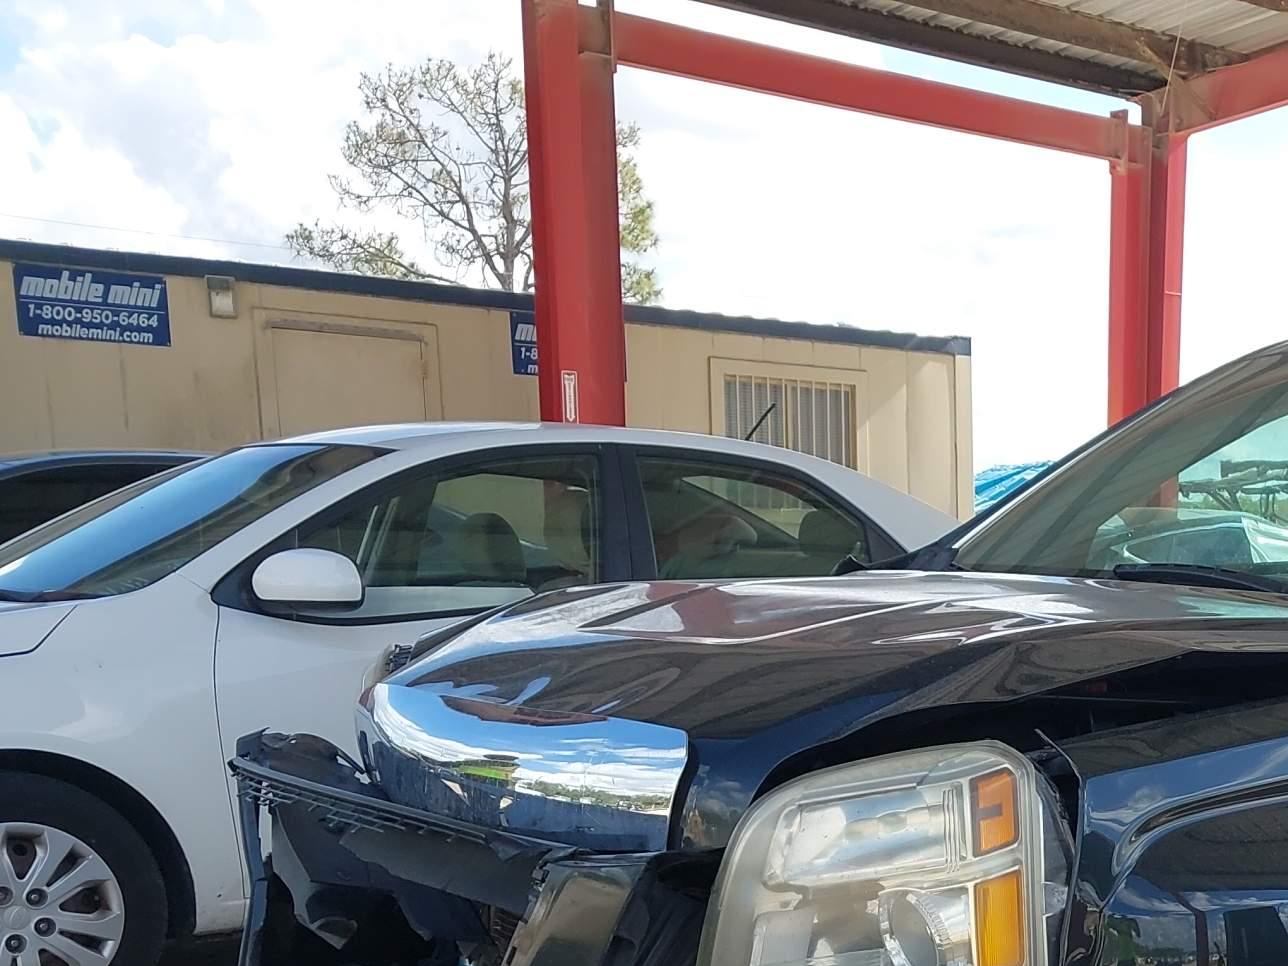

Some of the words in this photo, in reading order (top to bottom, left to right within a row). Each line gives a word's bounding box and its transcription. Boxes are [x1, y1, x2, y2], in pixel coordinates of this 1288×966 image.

[19, 270, 105, 303] mobile
[107, 282, 162, 307] mini
[27, 303, 158, 328] 1-800-950-6464
[38, 323, 153, 343] mobilemini.com
